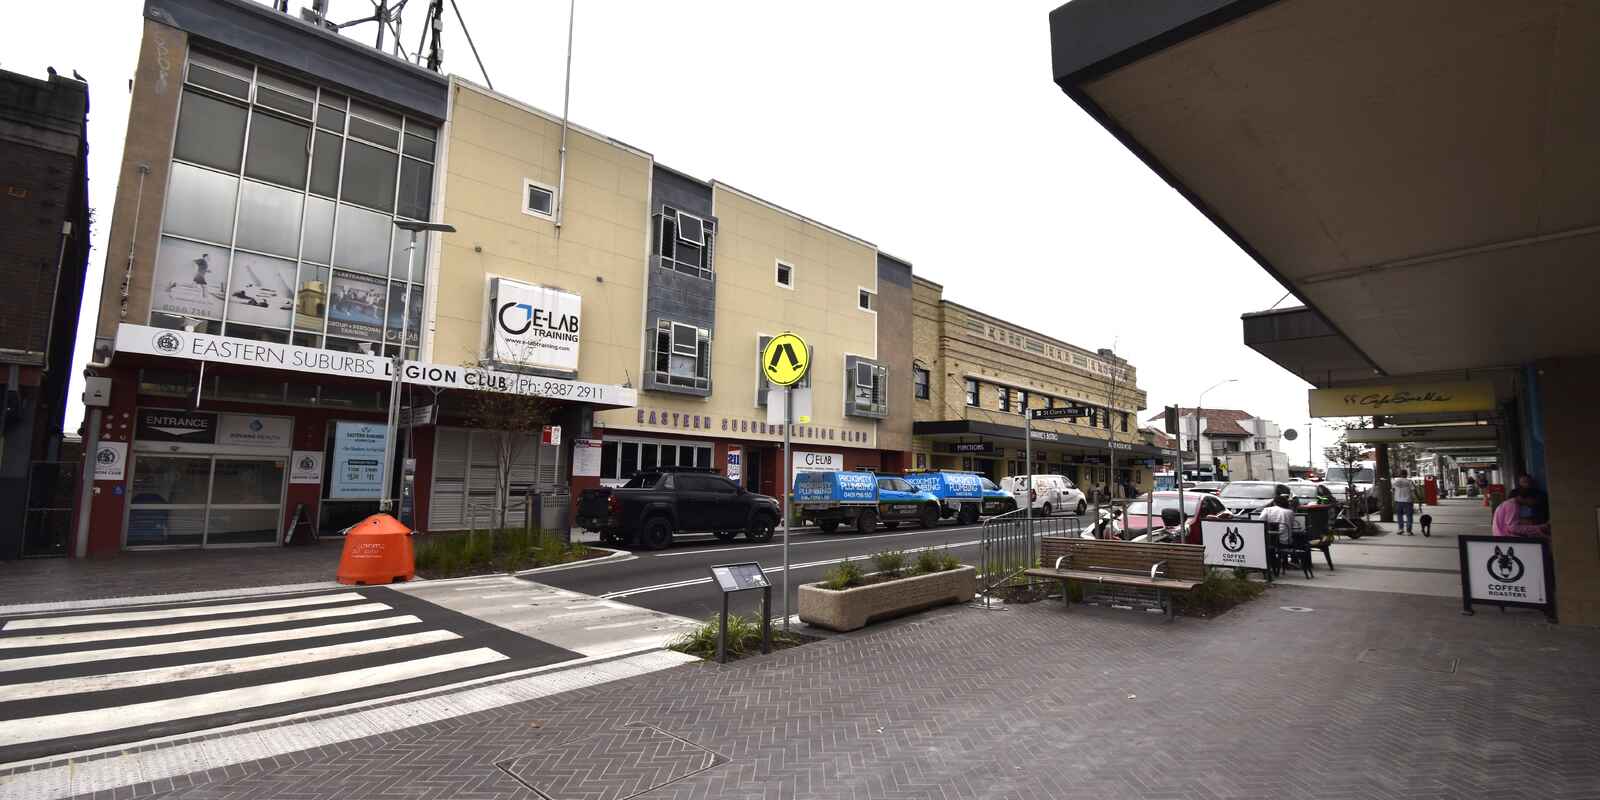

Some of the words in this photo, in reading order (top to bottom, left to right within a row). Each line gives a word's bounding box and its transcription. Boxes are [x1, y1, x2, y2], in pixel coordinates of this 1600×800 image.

[533, 308, 579, 333] E-LAB
[533, 328, 578, 343] TRAINING
[192, 338, 285, 364] EASTERN
[292, 350, 375, 375] SUBURBS
[464, 373, 507, 390] CLUB
[544, 382, 574, 396] 9387
[577, 385, 604, 400] 2911
[146, 415, 209, 428] ENTRANCE
[637, 409, 711, 429] EASTERN
[721, 418, 784, 436] SUBURBS
[792, 424, 834, 440] LEGION
[841, 430, 867, 443] CLUB
[840, 482, 874, 491] PLUMBING
[1488, 584, 1528, 592] COFFEE
